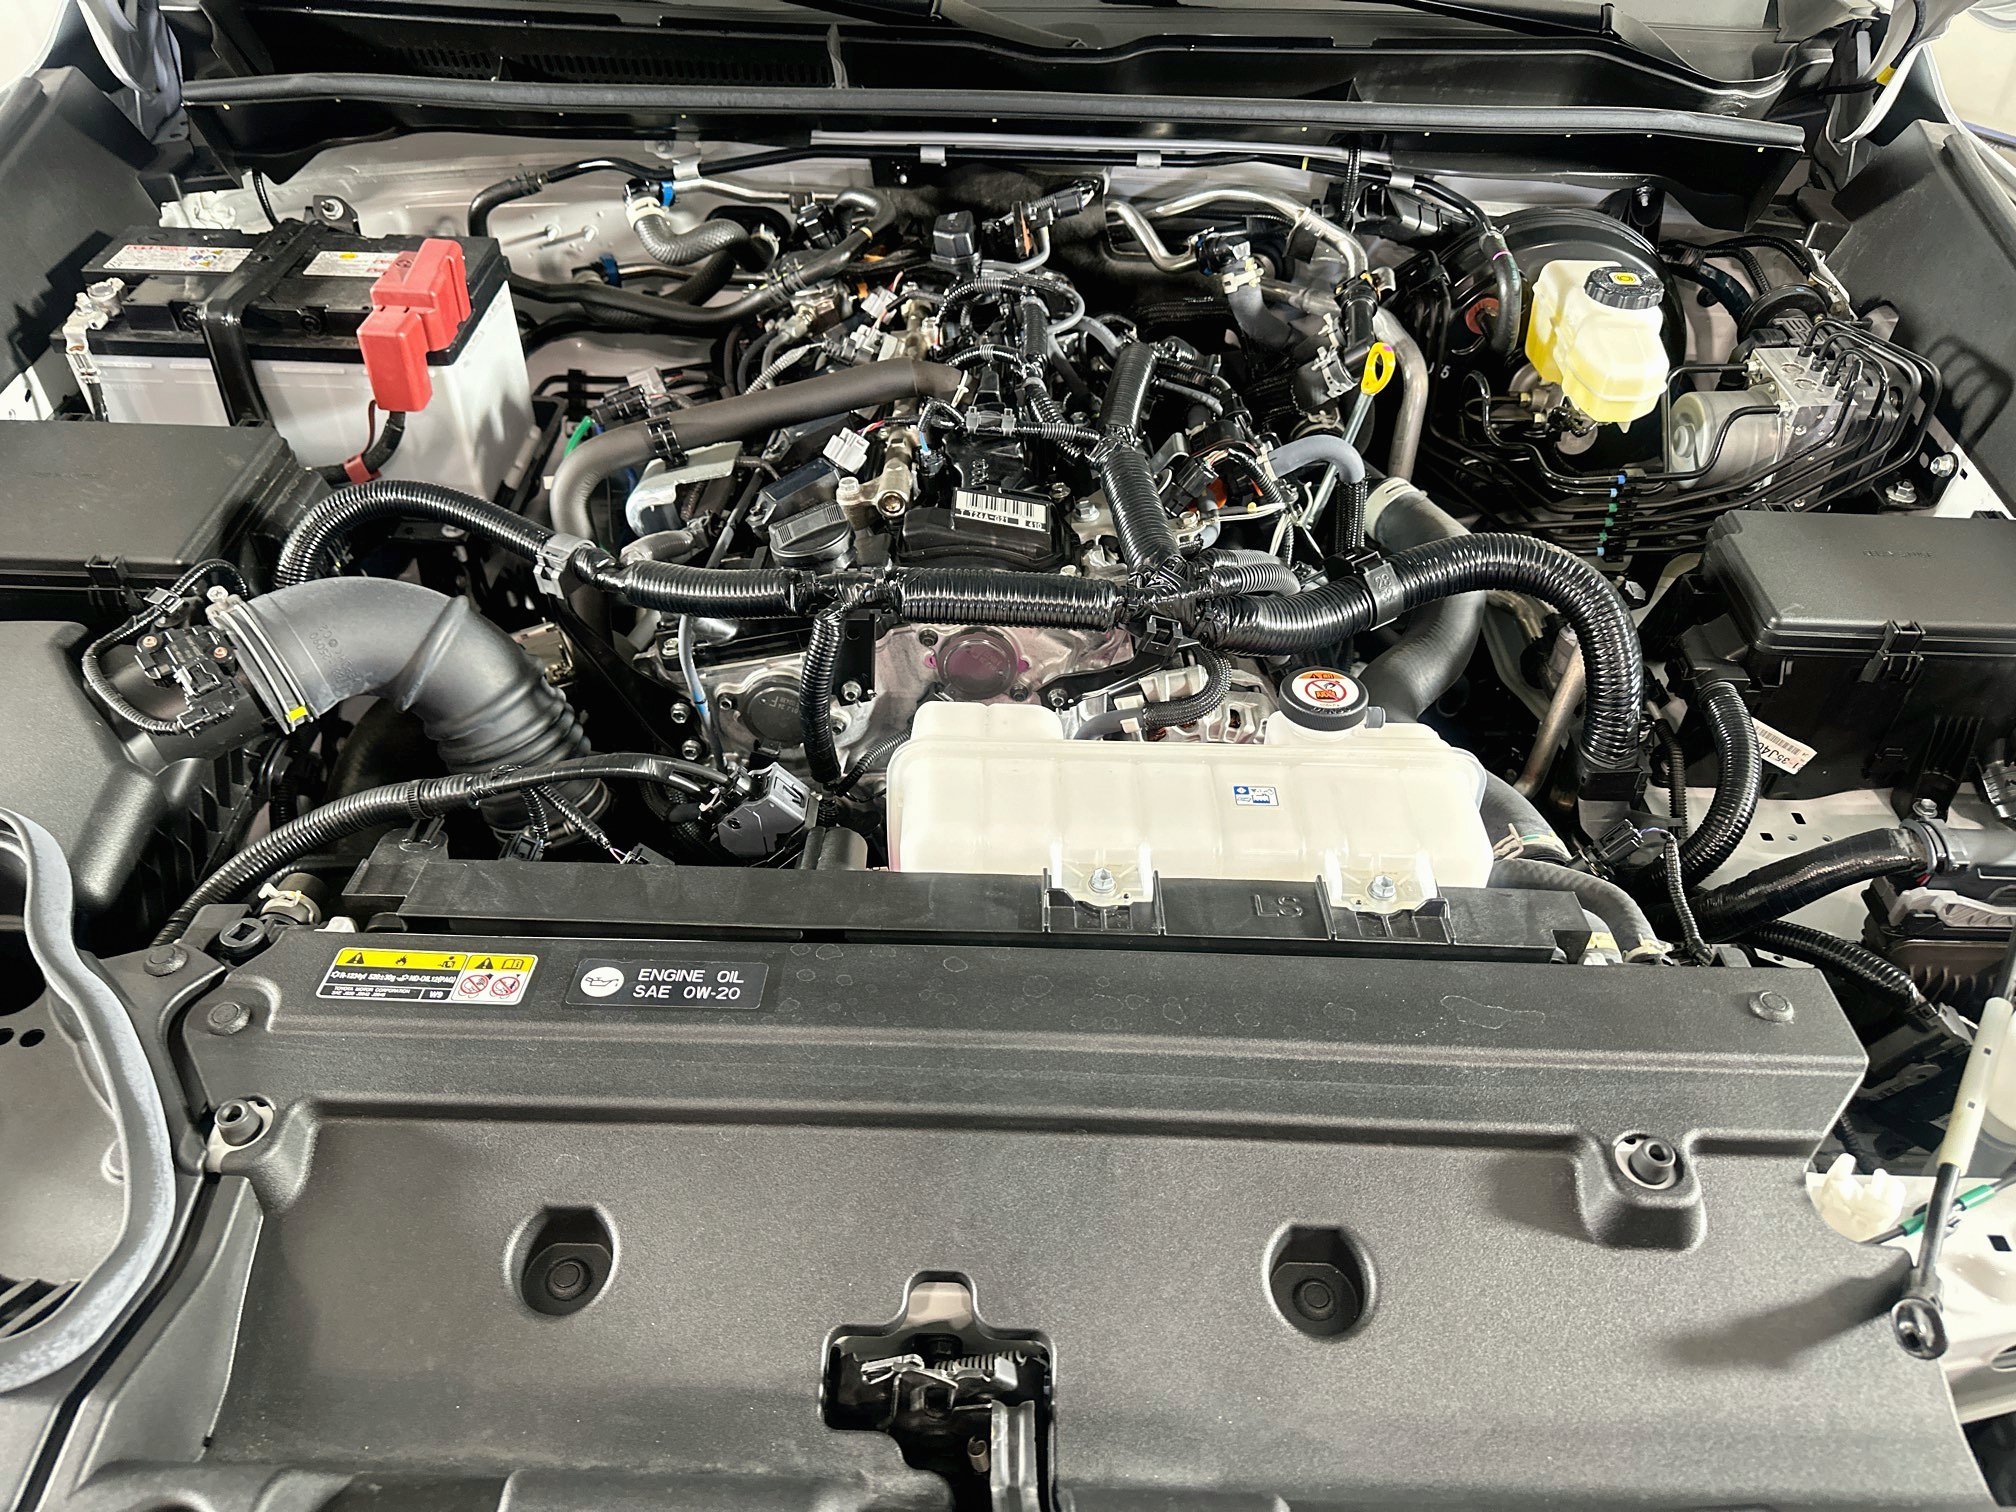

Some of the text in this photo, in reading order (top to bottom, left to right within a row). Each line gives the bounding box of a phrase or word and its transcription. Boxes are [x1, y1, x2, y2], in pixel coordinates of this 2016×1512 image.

[637, 968, 745, 984] ENGINE OIL
[632, 985, 741, 1000] SAE 0W-20
